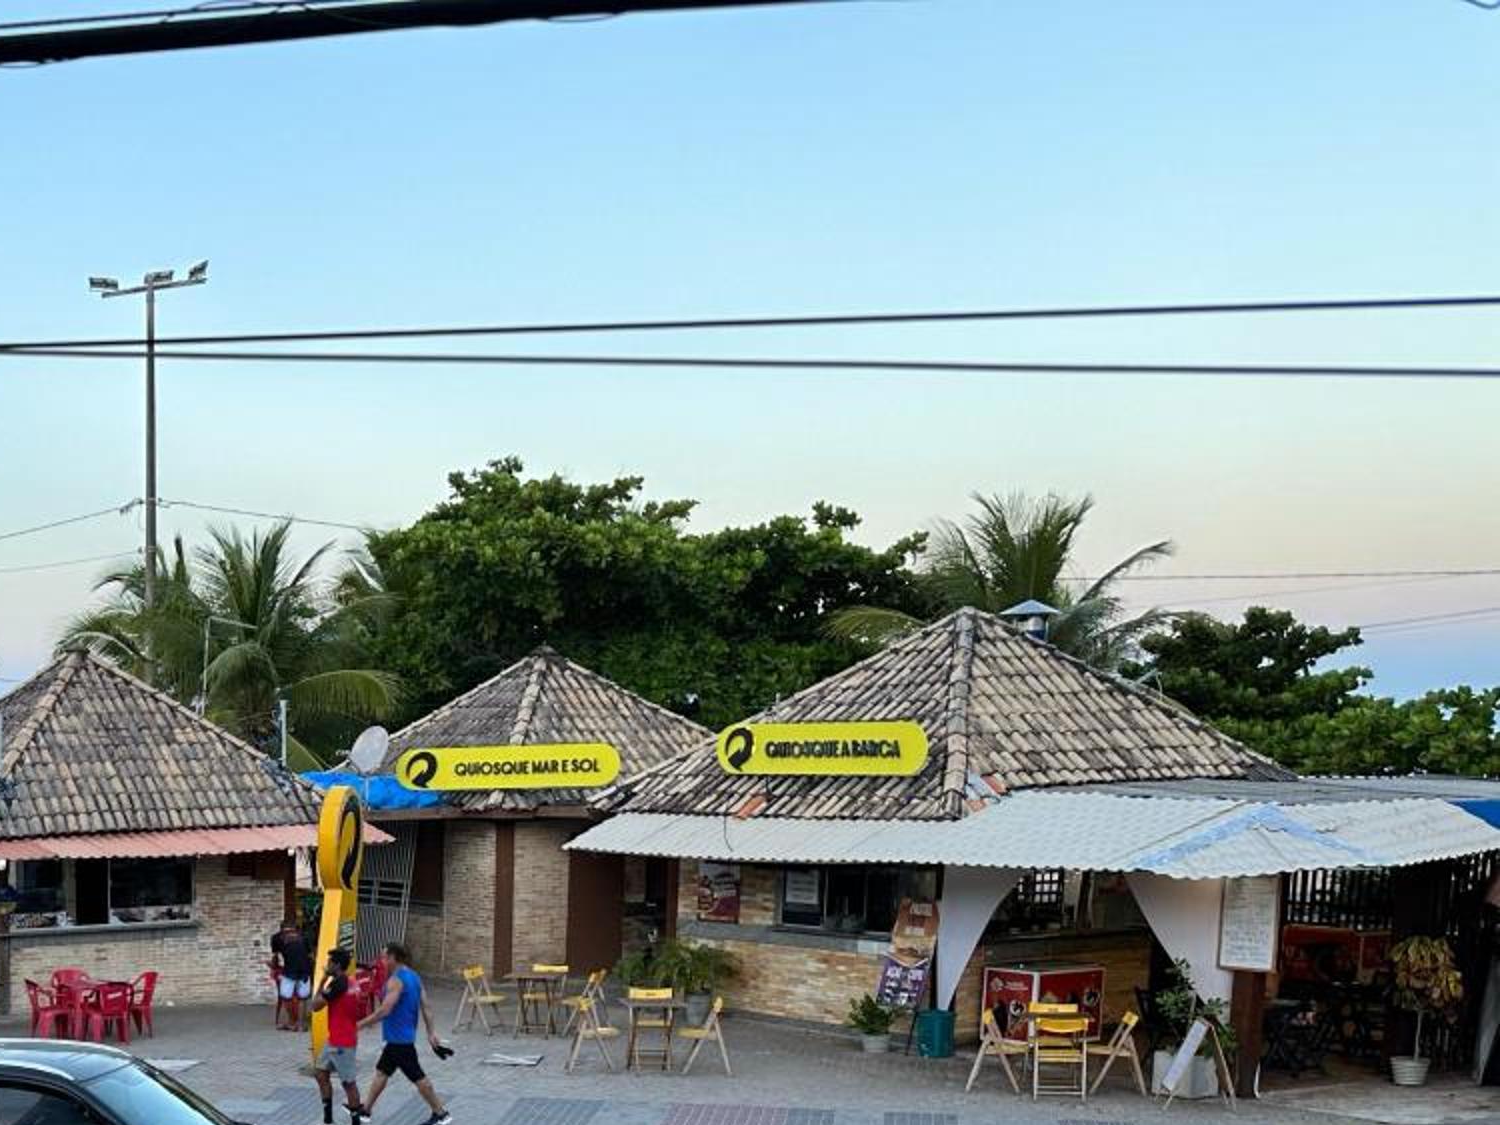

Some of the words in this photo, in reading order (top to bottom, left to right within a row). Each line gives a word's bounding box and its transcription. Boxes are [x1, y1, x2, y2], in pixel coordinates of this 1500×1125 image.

[454, 760, 531, 776] QUIOSQUE
[532, 759, 559, 774] MAR
[562, 759, 568, 773] E
[571, 758, 600, 773] SOL
